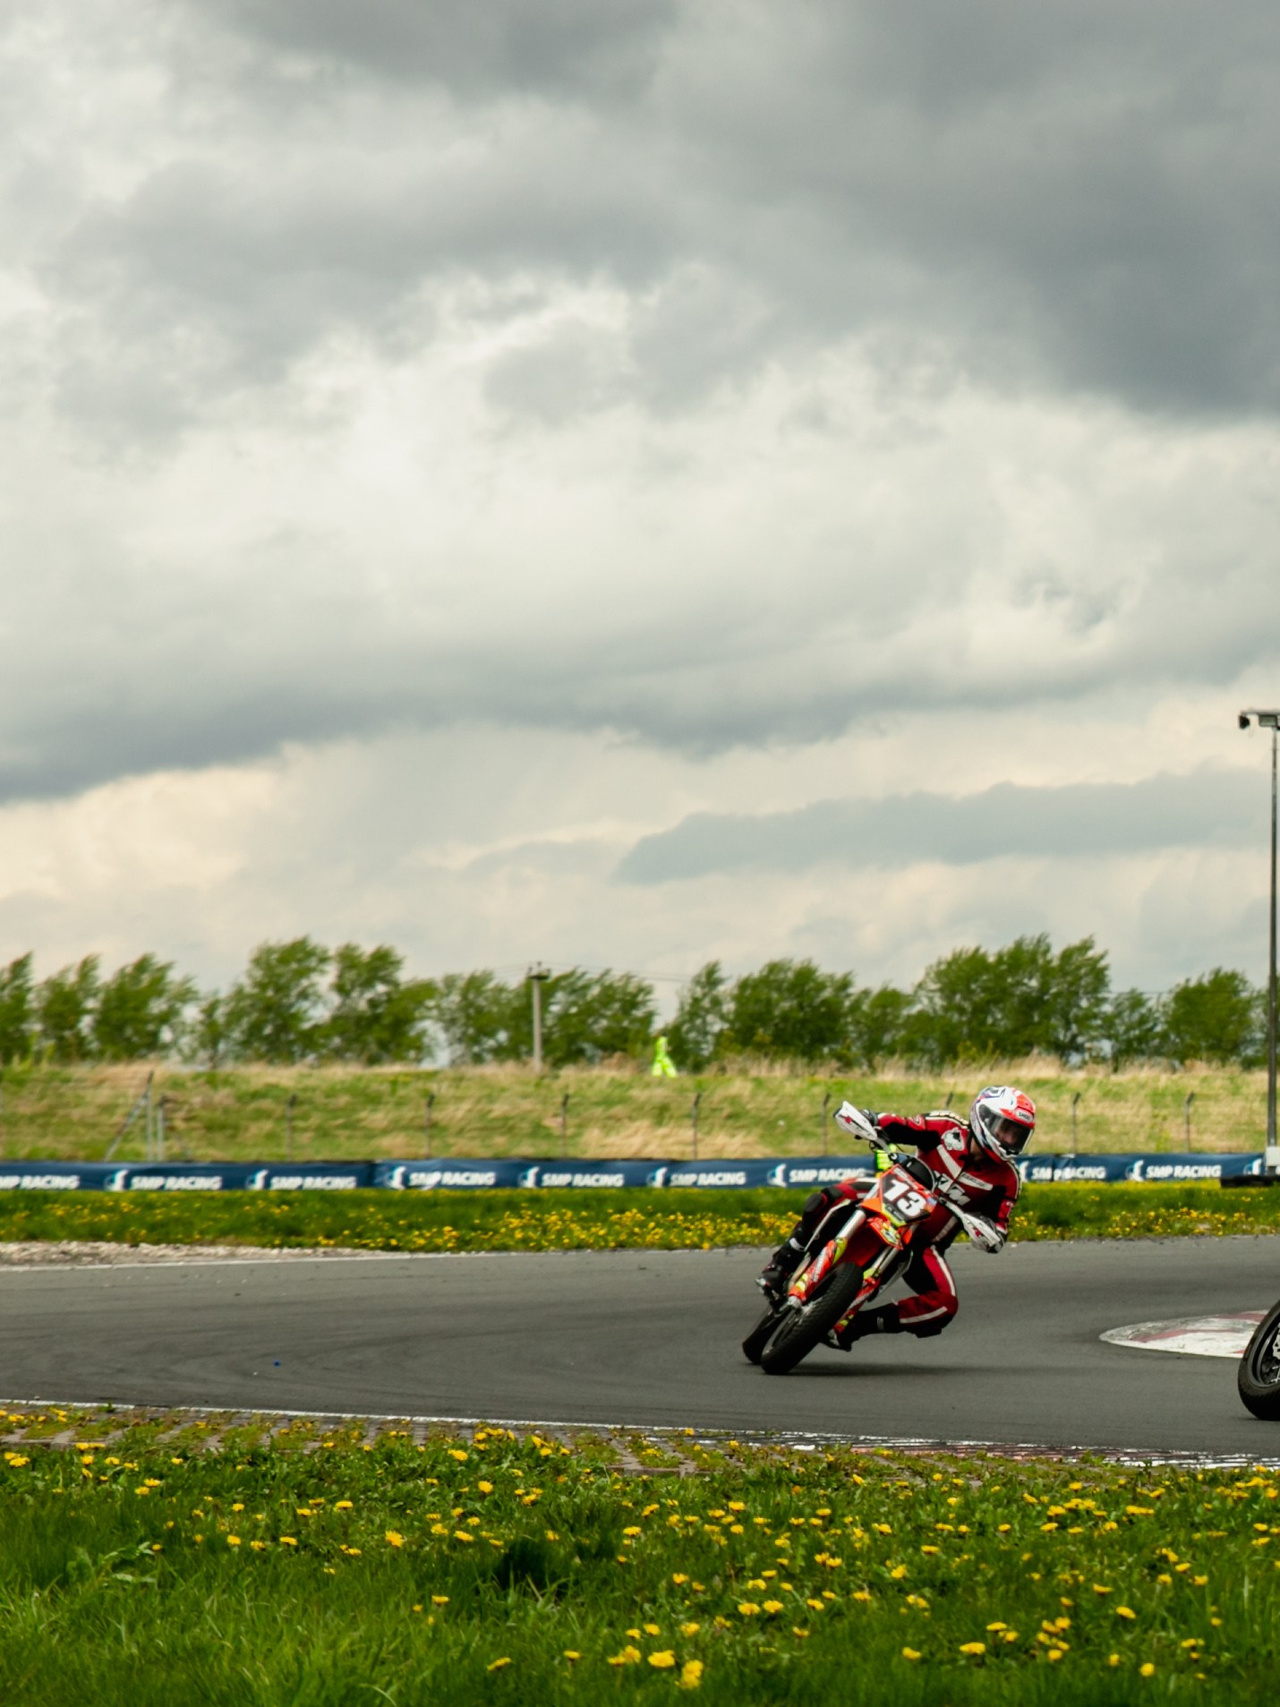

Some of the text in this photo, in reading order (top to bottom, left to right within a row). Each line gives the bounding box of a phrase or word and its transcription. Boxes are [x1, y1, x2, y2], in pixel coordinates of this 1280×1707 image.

[409, 1172, 496, 1186] SMP RACING
[670, 1172, 746, 1186] SMP RACING
[789, 1168, 865, 1182] SMP RACING
[1062, 1166, 1106, 1180] RACING
[1146, 1165, 1222, 1179] SMP RACING
[0, 1175, 80, 1190] MP RACING
[131, 1176, 222, 1190] SMP RACING
[270, 1176, 357, 1190] SMP RACING
[541, 1173, 624, 1187] SMP RACING
[883, 1179, 926, 1217] 13
